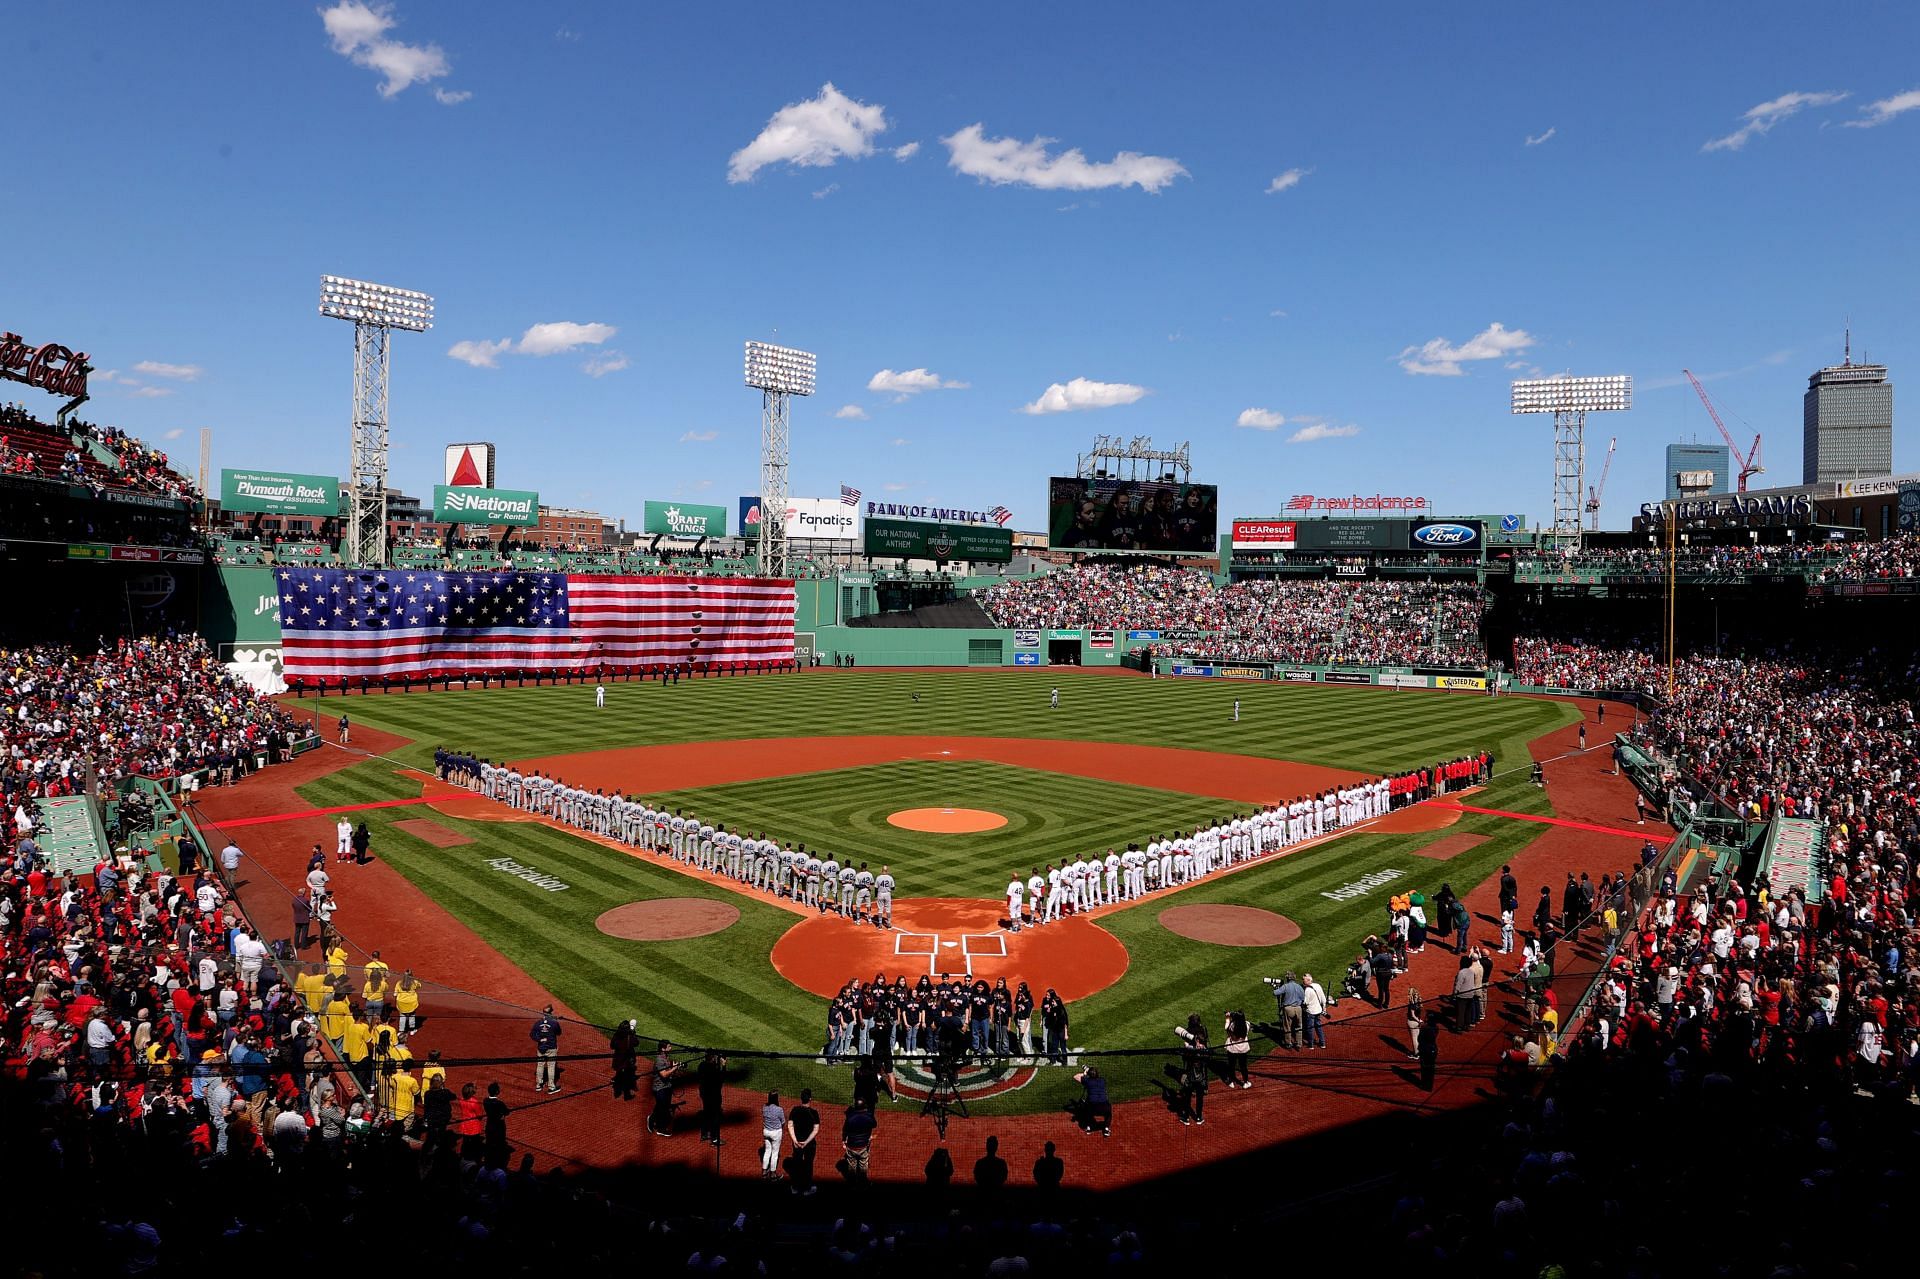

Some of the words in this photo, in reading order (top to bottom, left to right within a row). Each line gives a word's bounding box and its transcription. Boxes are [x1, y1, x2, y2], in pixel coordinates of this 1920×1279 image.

[1080, 434, 1124, 473] John
[1124, 435, 1192, 472] Hancock
[237, 482, 293, 496] Plymouth
[296, 486, 326, 498] Rock
[1854, 484, 1870, 494] LEE
[117, 494, 136, 503] BLACK
[137, 496, 153, 505] LIVES
[154, 498, 175, 508] MATTER
[1317, 498, 1350, 509] new
[1352, 494, 1426, 509] balance
[1729, 494, 1811, 517] ADAMS
[868, 502, 907, 516] BANK
[911, 505, 927, 518] OF
[931, 508, 987, 522] AMERICA
[667, 513, 708, 526] DRAFT
[799, 512, 853, 526] Fanatics
[672, 524, 706, 534] KINGS
[875, 529, 888, 537] OUR
[889, 530, 920, 539] NATIONAL
[1239, 525, 1290, 534] CLEAResult
[1427, 526, 1464, 542] Ford
[885, 540, 910, 549] ANTHEM
[177, 552, 204, 562] Safelite
[1249, 669, 1262, 678] CITY
[1467, 679, 1479, 688] TEA
[482, 858, 570, 892] Aspiration
[844, 873, 855, 881] 42
[880, 880, 890, 888] 42
[1320, 868, 1407, 901] Aspiration
